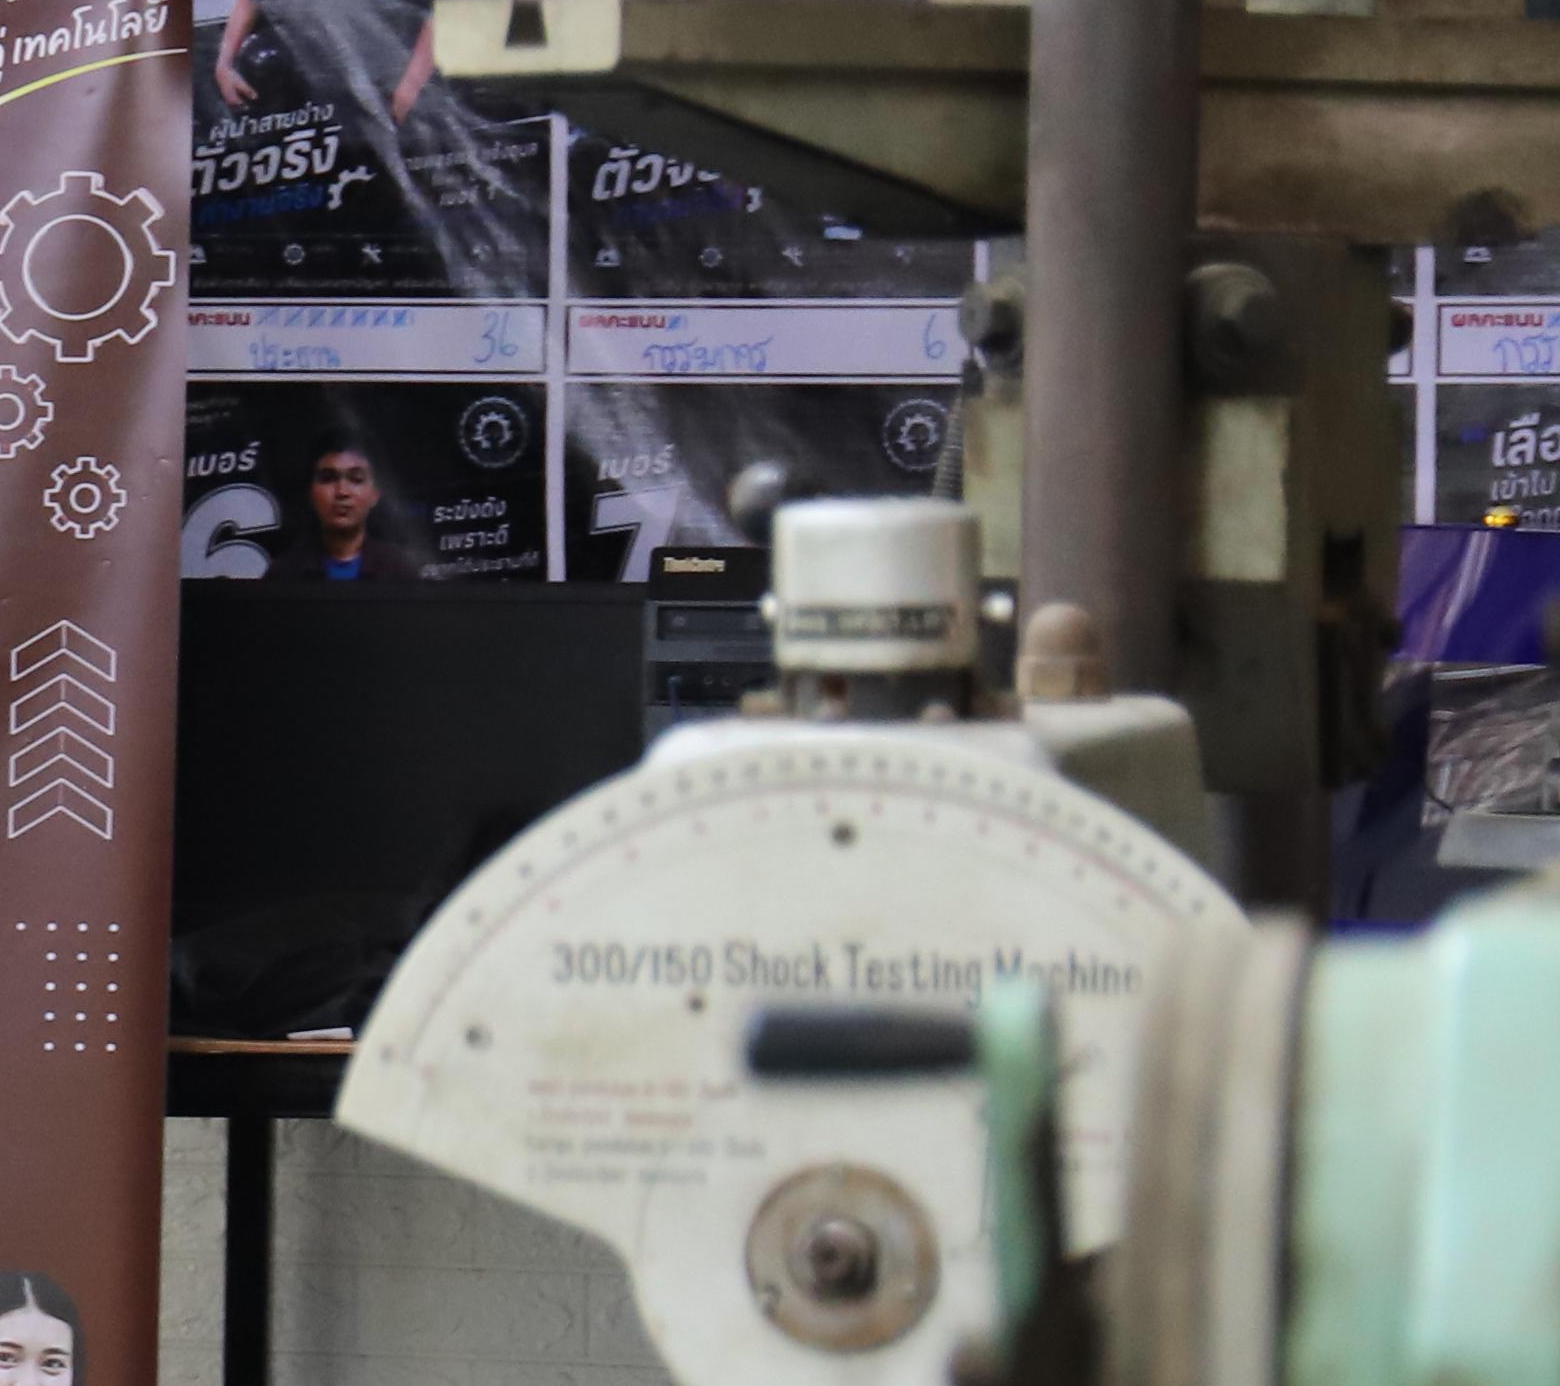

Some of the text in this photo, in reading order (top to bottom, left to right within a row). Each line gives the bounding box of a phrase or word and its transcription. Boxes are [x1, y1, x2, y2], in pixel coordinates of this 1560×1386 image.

[186, 441, 262, 478] เบอร์
[723, 941, 831, 991] Shock
[843, 942, 984, 1009] Testing
[993, 946, 1144, 997] Mchine
